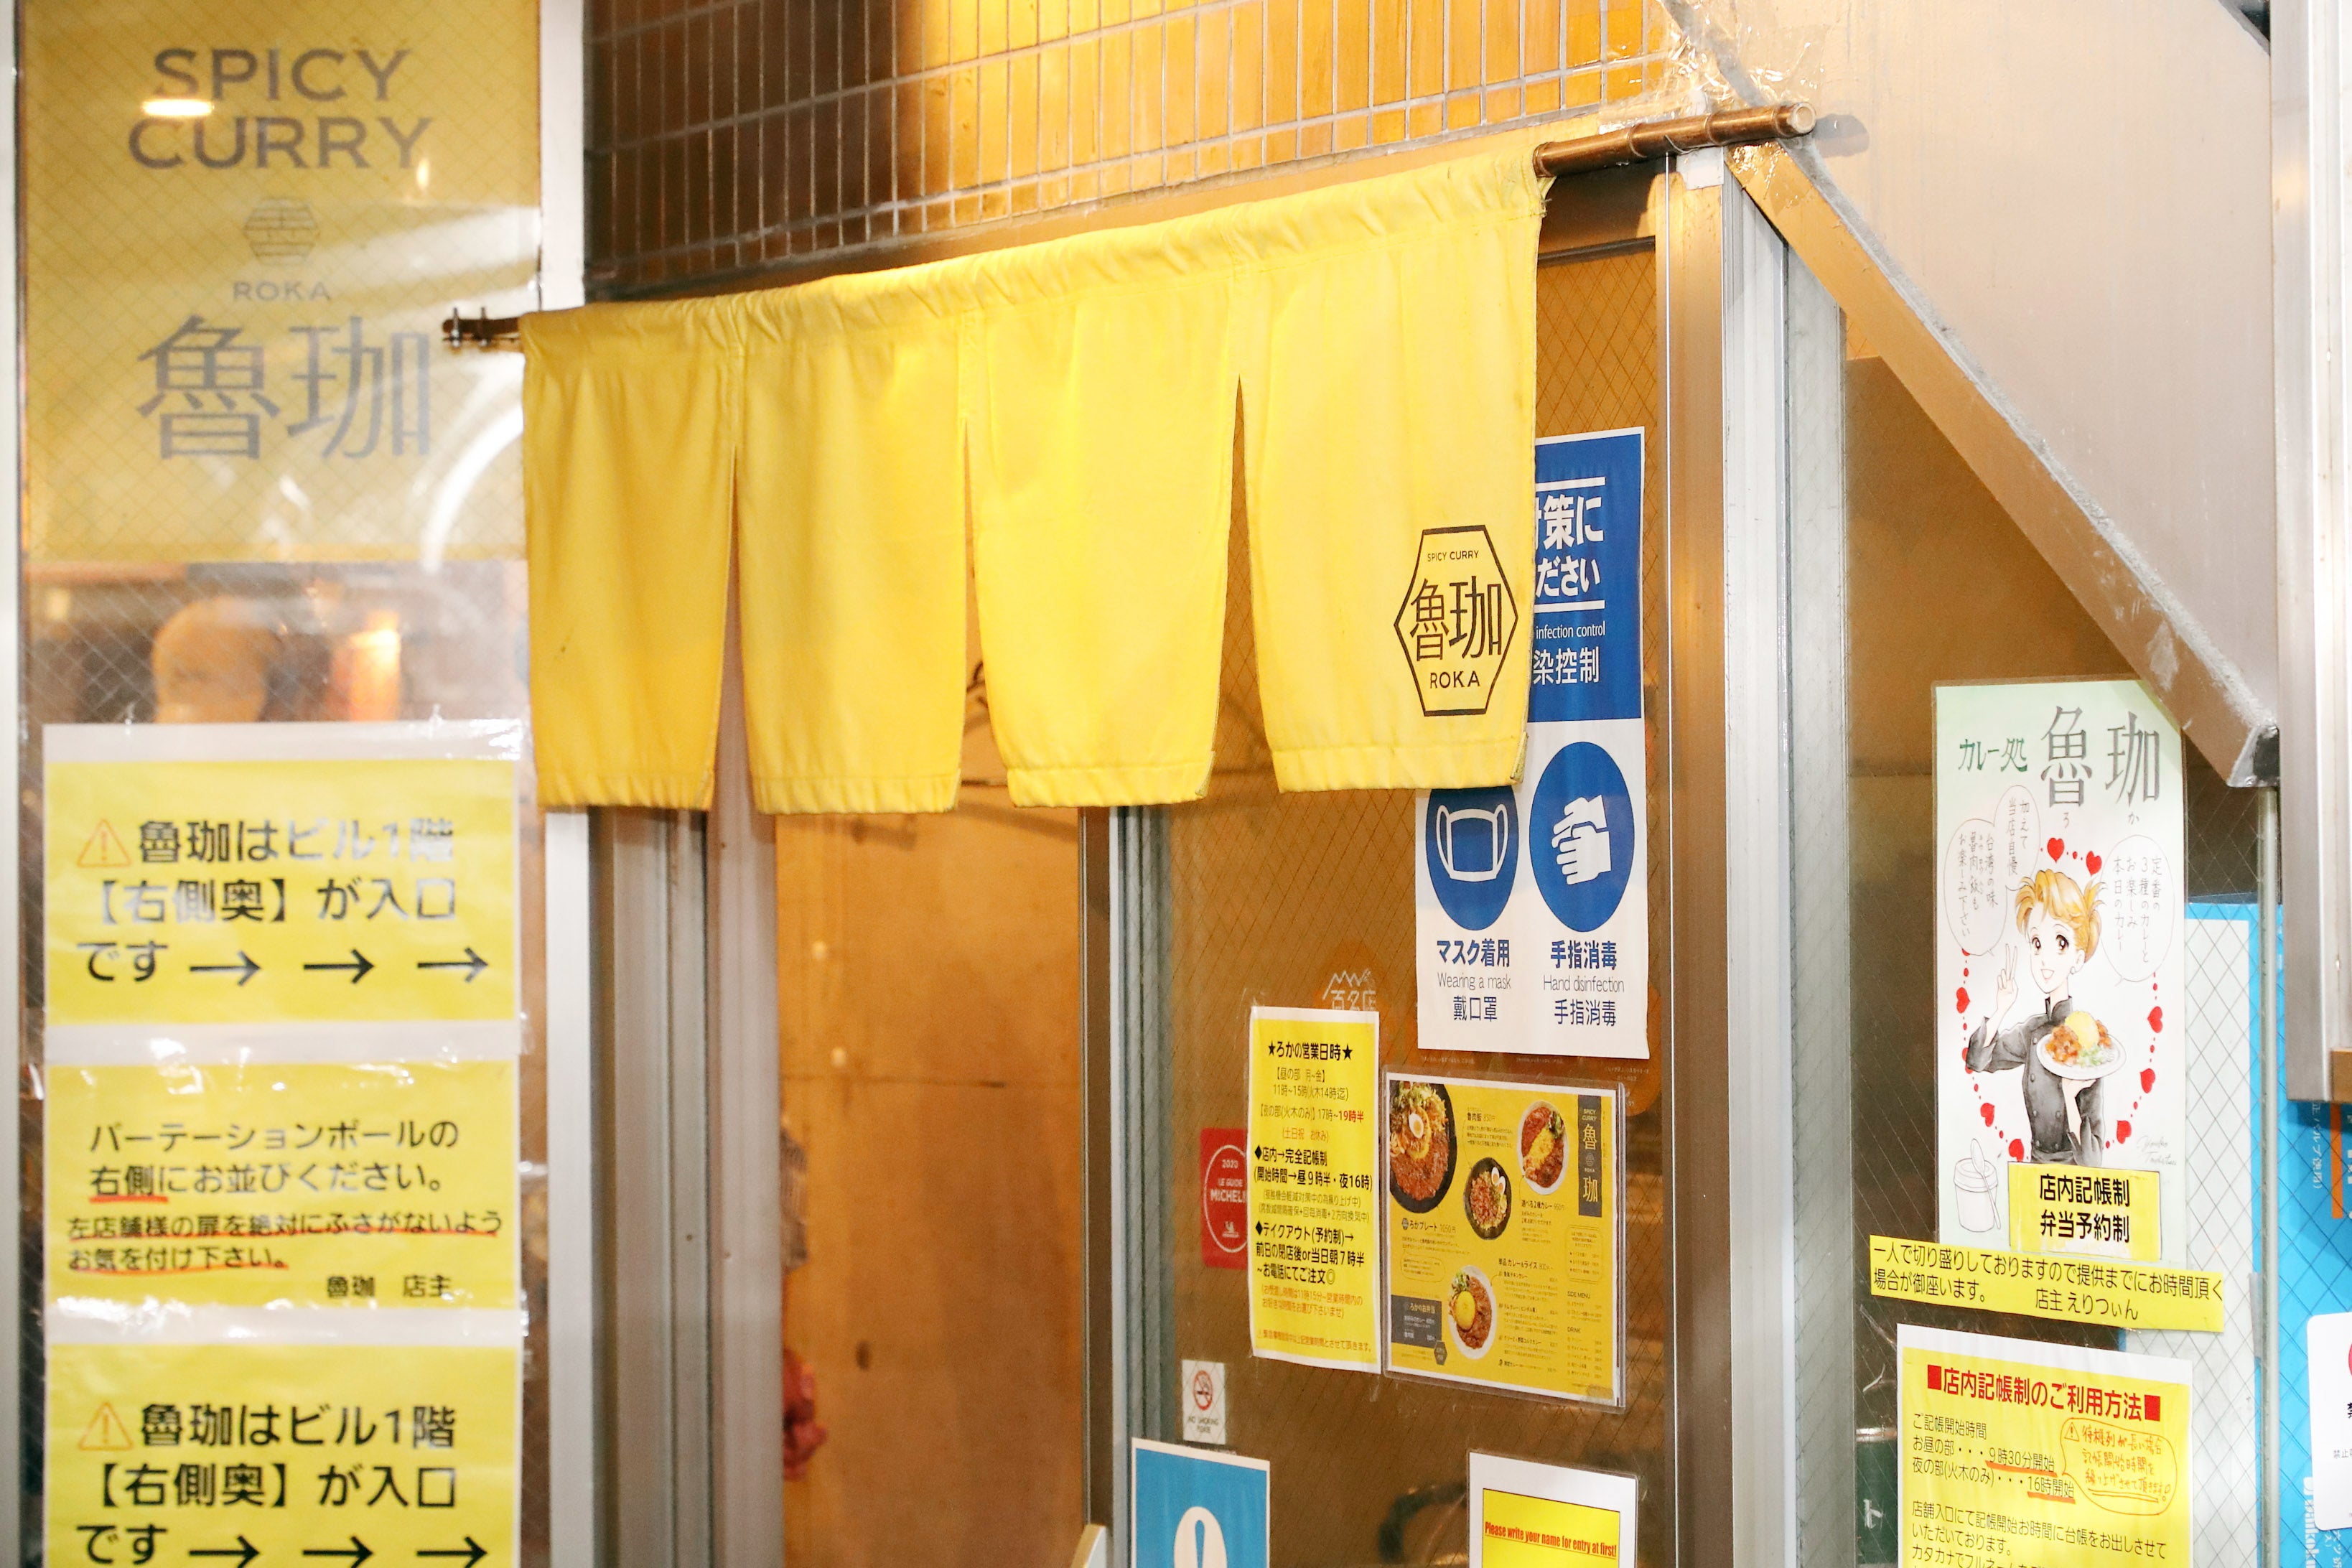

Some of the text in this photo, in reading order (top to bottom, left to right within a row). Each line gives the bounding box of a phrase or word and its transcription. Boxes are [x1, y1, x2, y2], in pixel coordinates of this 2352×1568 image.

[154, 47, 412, 102] SPICY
[129, 116, 434, 169] CURRY
[233, 281, 331, 302] ROKA
[136, 313, 431, 460] 魯珈
[1535, 494, 1604, 550] 策に
[1427, 550, 1479, 561] SPICY CURRY
[1410, 575, 1503, 661] 魯珈
[1536, 621, 1605, 639] infection control
[1430, 671, 1480, 689] ROKA
[1958, 705, 2160, 808] カレー処 魯珈
[139, 817, 454, 863] 魯珈はビル1階
[2127, 856, 2137, 928] お楽しみ
[2152, 857, 2162, 911] 定番の
[2114, 856, 2124, 953] 本日のカレー
[76, 941, 169, 983] です
[1437, 938, 1510, 967] マスク着用
[1551, 940, 1617, 970] 手指消毒
[1437, 972, 1511, 990] Wearing a mask
[1544, 975, 1570, 991] Hand
[1453, 996, 1497, 1022] 戴口罩
[1554, 999, 1616, 1027] 手指消毒
[89, 1162, 443, 1196] 右側にお並びください。
[2040, 1174, 2130, 1207] 店内記帳制
[2040, 1209, 2129, 1243] 弁当予約制
[69, 1245, 286, 1271] お気を付け下さい。
[327, 1275, 452, 1298] 魯珈 店主
[1874, 1267, 1985, 1303] 場合が御座います。
[2035, 1288, 2061, 1311] 店主
[141, 1404, 457, 1448] 魯珈はビル1階
[1913, 1413, 1987, 1439] ご記帳開始時間
[76, 1522, 168, 1566] です
[1485, 1521, 1616, 1557] Please write your name for entry at first!
[1912, 1523, 2011, 1557] いただいております。
